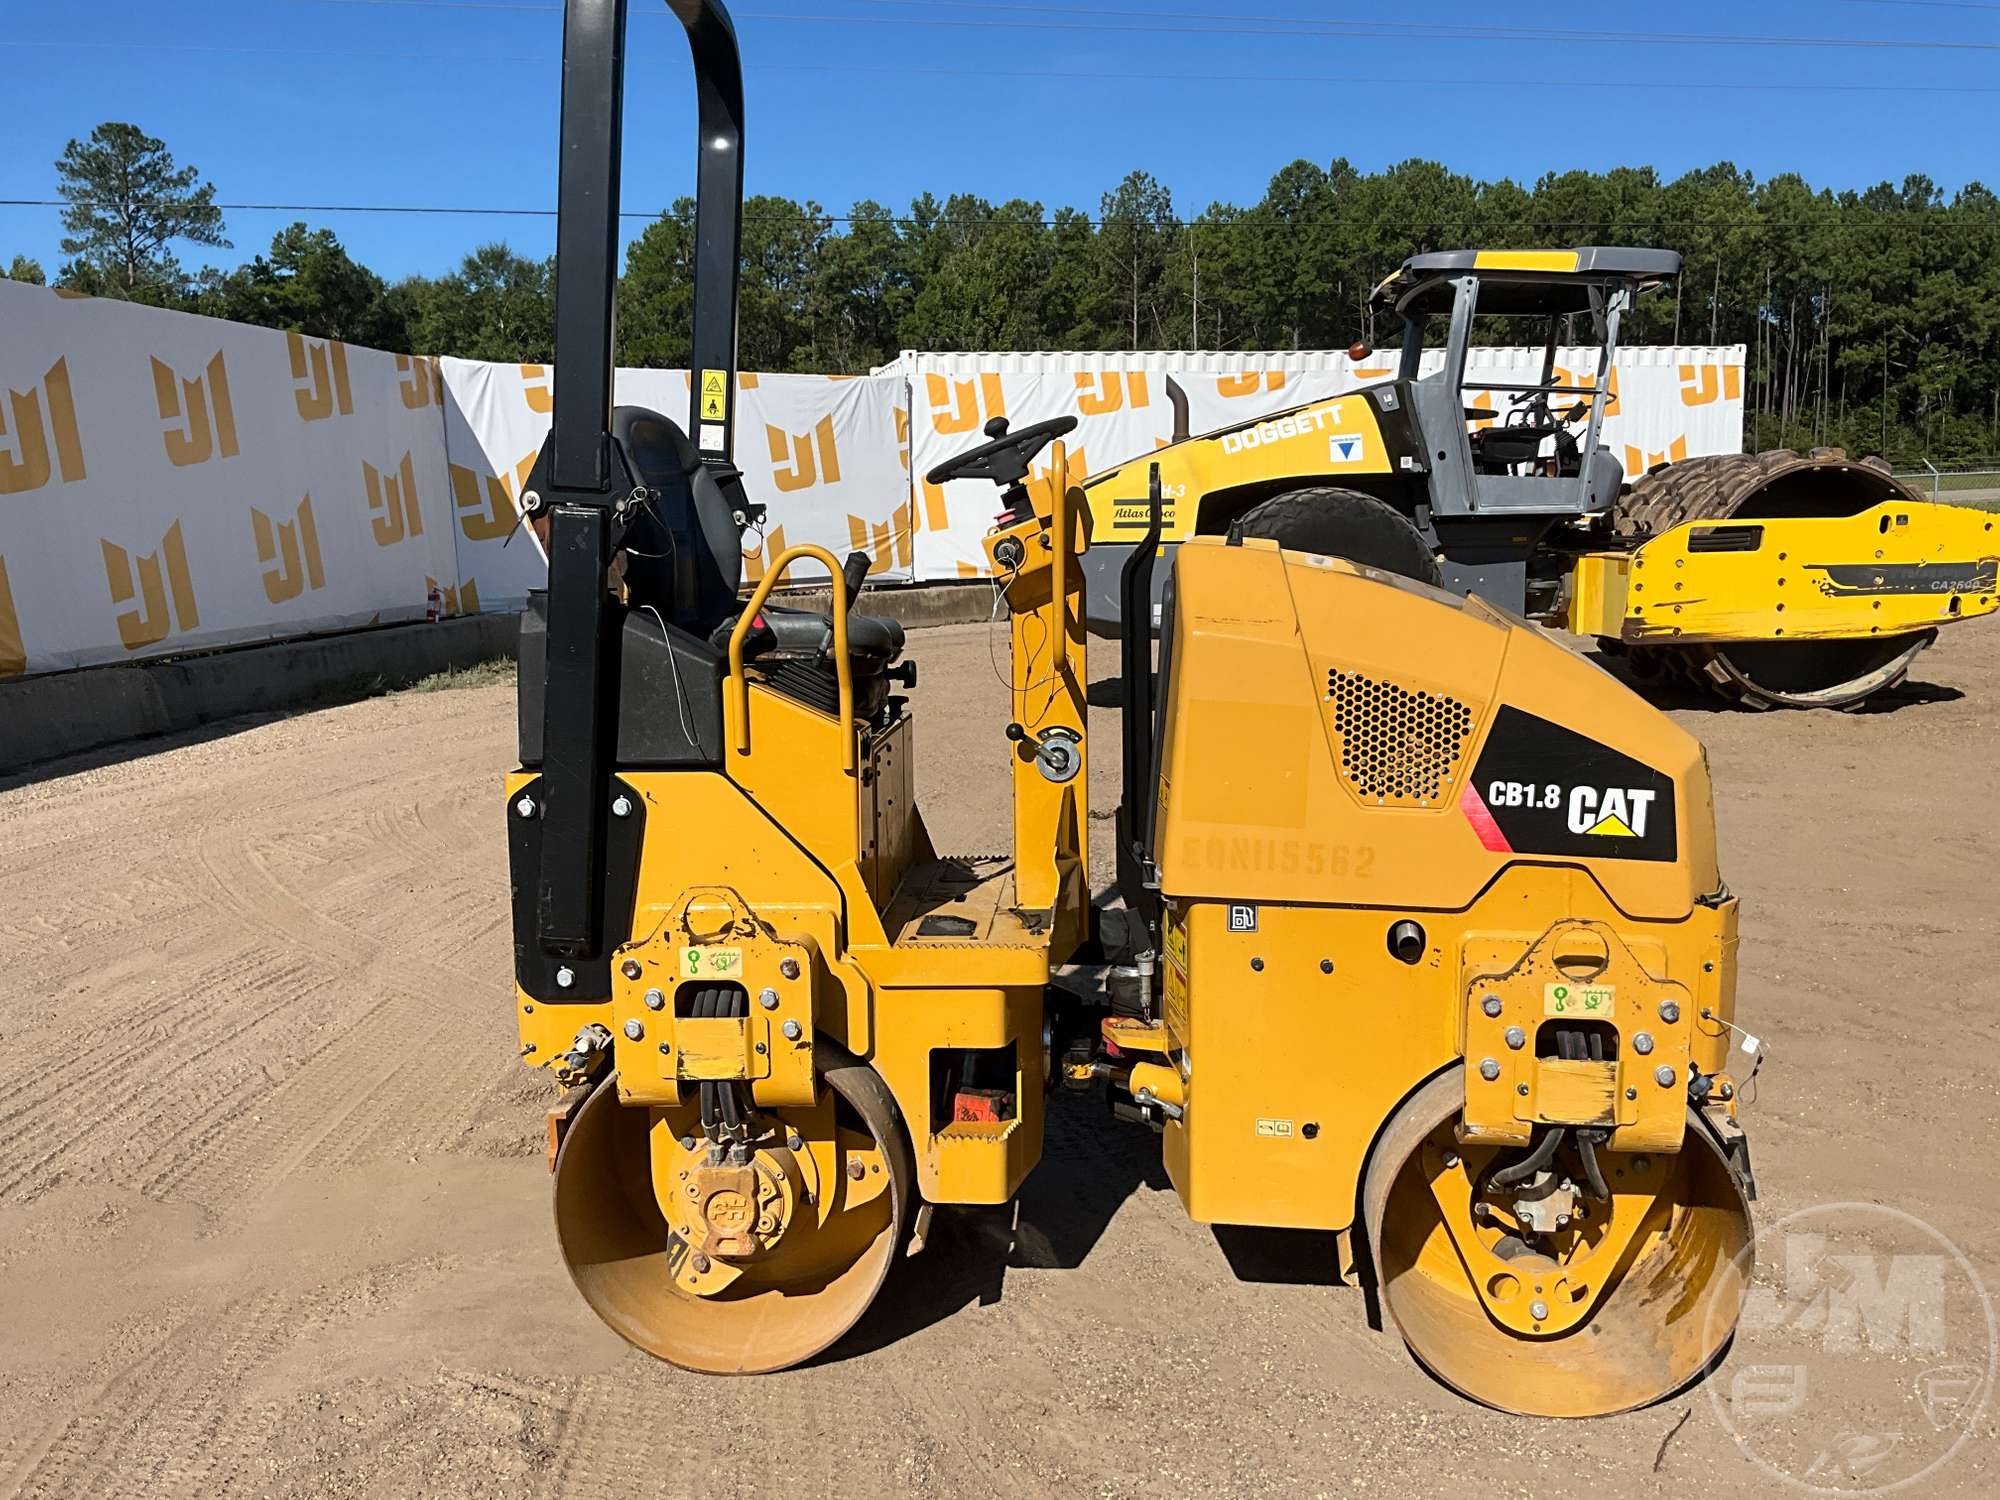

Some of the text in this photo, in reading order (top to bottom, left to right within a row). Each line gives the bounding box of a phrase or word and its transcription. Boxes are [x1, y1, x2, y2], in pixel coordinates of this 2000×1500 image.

[1221, 404, 1344, 455] DOGGETT
[1114, 508, 1176, 519] Atlas Cco
[1489, 780, 1656, 838] CB1.8 CAT
